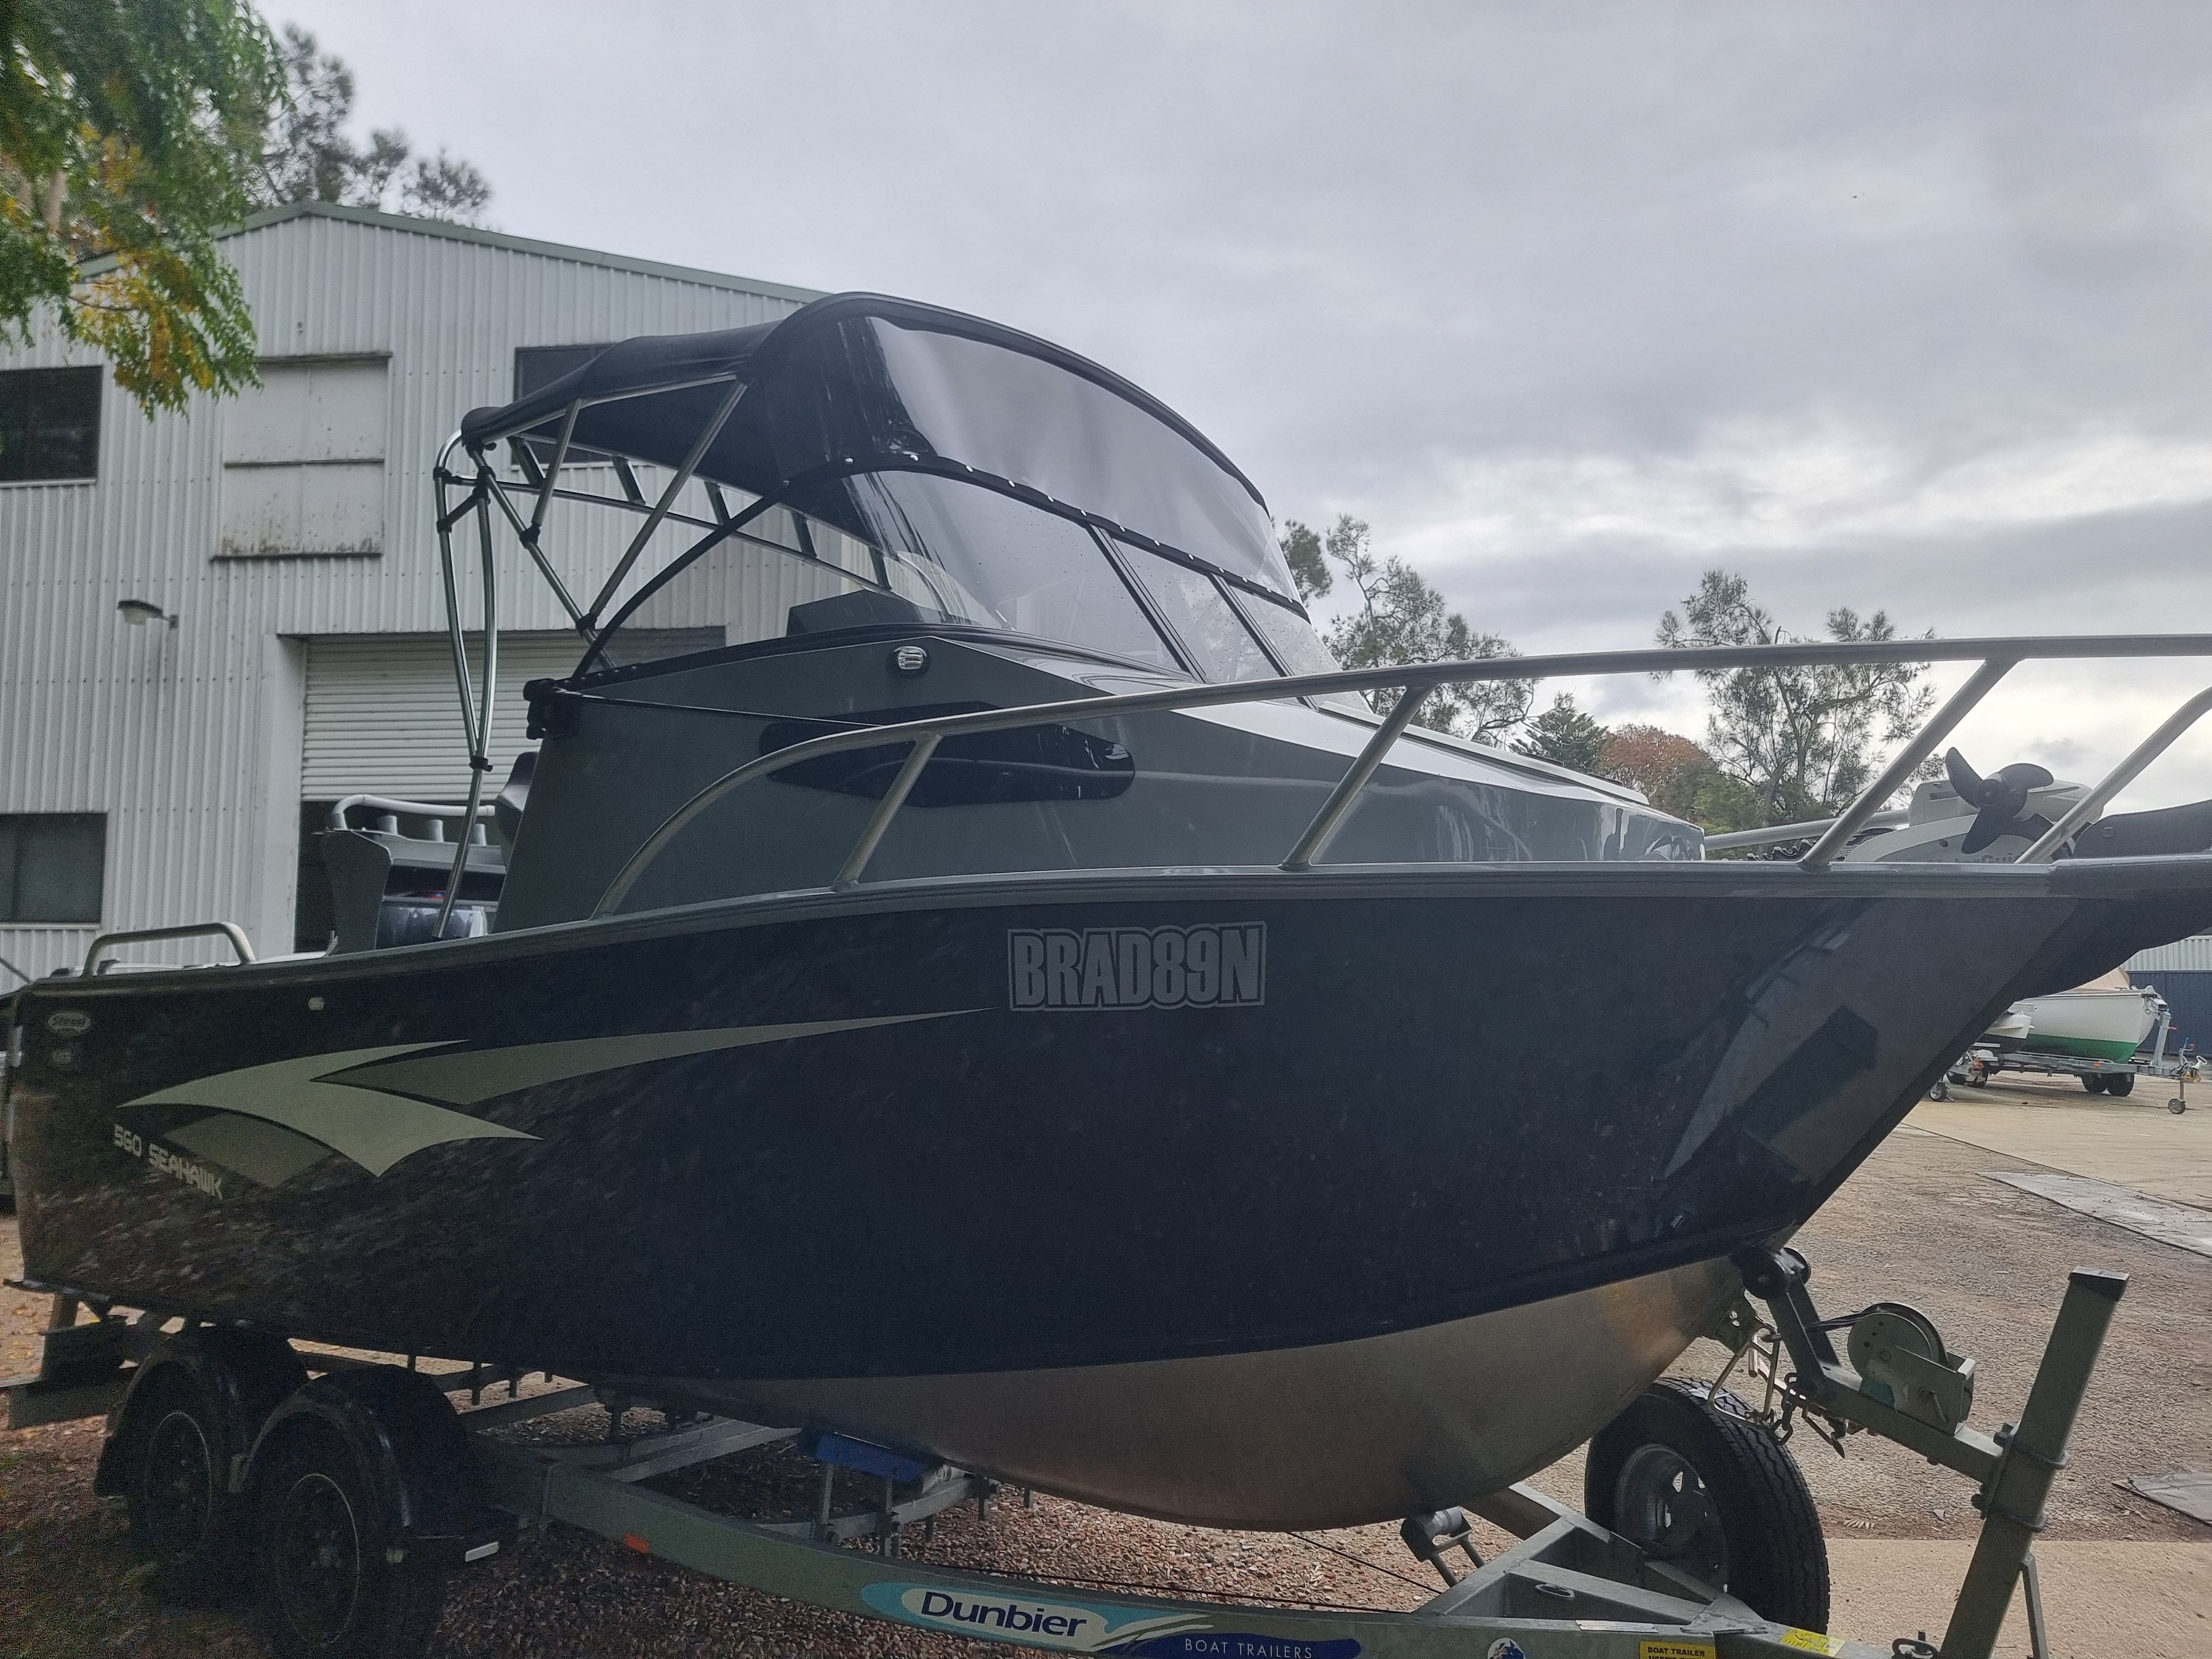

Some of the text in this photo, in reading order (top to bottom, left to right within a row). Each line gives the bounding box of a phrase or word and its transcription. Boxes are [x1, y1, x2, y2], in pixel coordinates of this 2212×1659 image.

[1009, 922, 1267, 1011] BRAD89N
[149, 1142, 223, 1200] SEAHAWK
[921, 1591, 1087, 1637] Dunbier
[1185, 1638, 1312, 1659] BOAT TRAILERS
[1647, 1646, 1706, 1657] BOAT TRAILER
